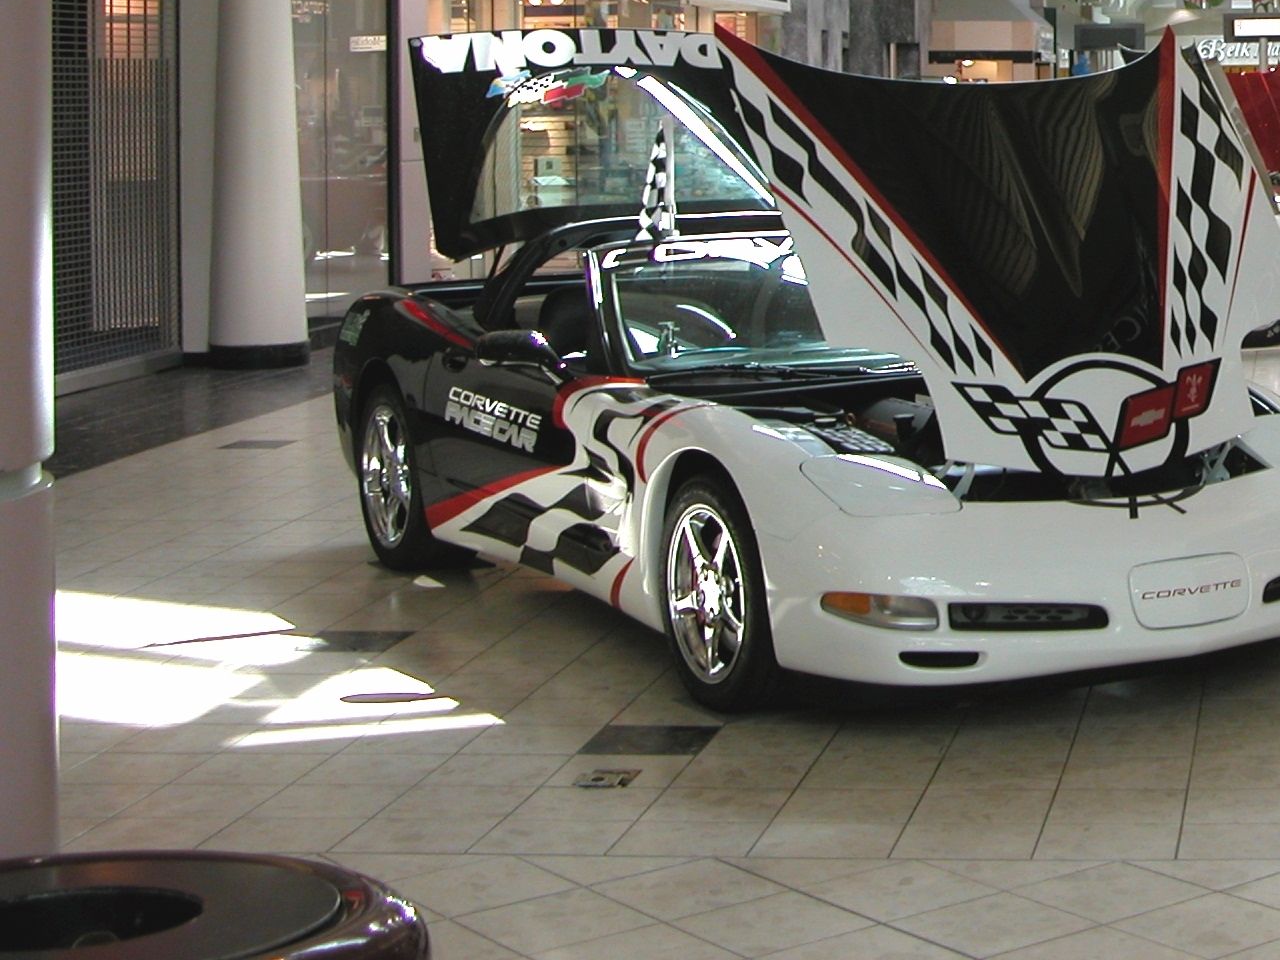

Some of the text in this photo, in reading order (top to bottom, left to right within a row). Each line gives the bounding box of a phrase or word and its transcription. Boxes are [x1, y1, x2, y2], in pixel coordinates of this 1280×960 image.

[418, 28, 724, 74] DAYTONA
[1197, 39, 1250, 62] Belk
[448, 386, 542, 430] CORVETTE
[1141, 578, 1242, 600] CORVETTE
